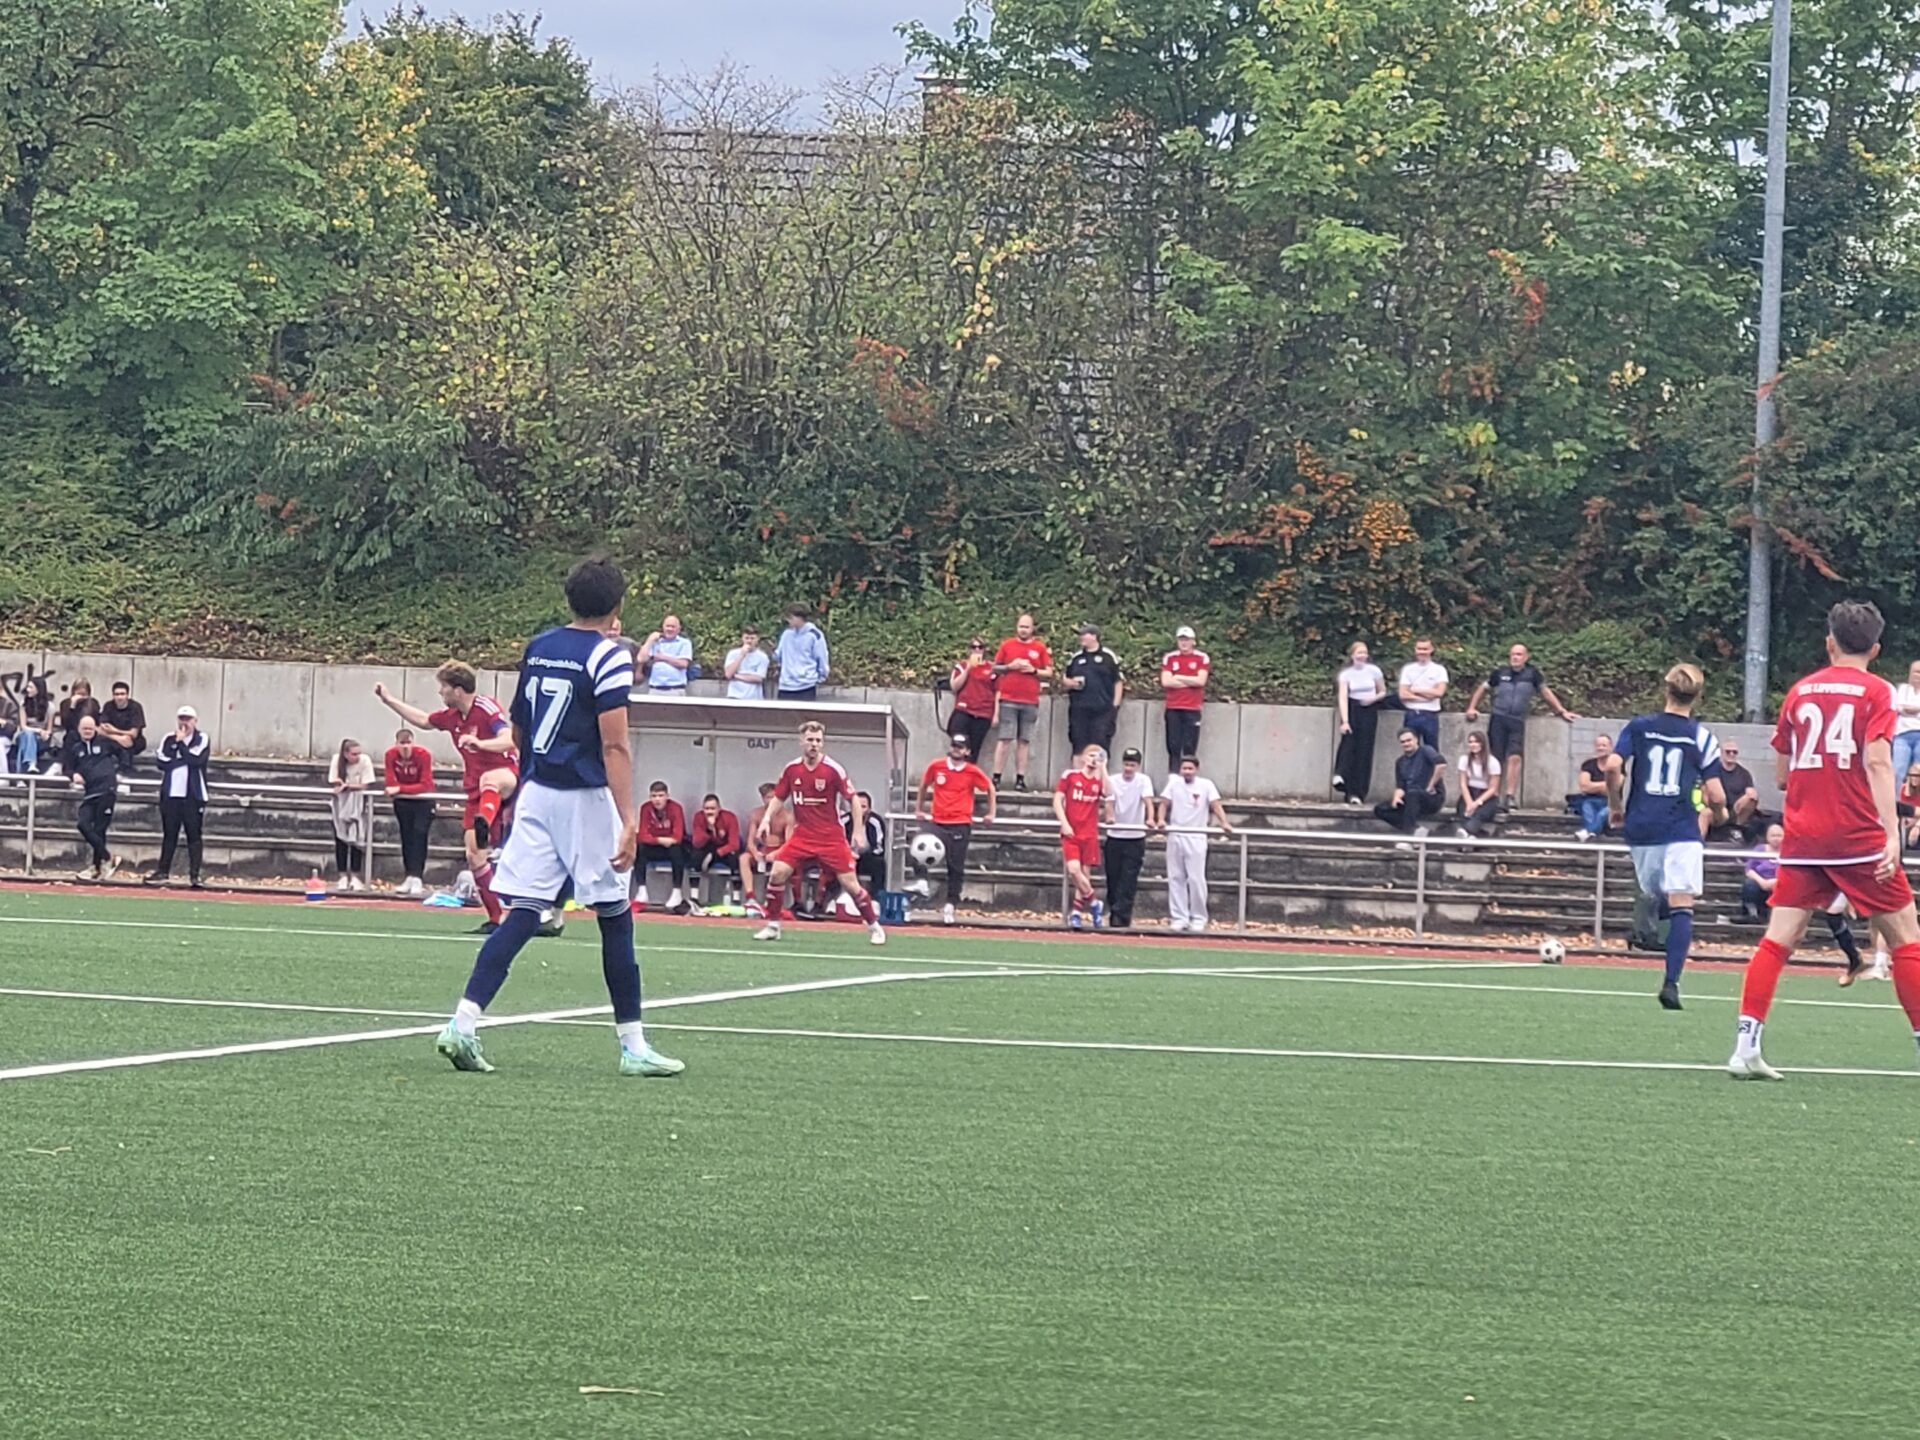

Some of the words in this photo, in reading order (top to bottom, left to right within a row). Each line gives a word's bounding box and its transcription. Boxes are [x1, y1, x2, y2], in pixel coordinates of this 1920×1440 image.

[525, 676, 573, 754] 17
[747, 738, 777, 750] GAST
[1796, 702, 1857, 769] 24
[1645, 745, 1684, 796] 11
